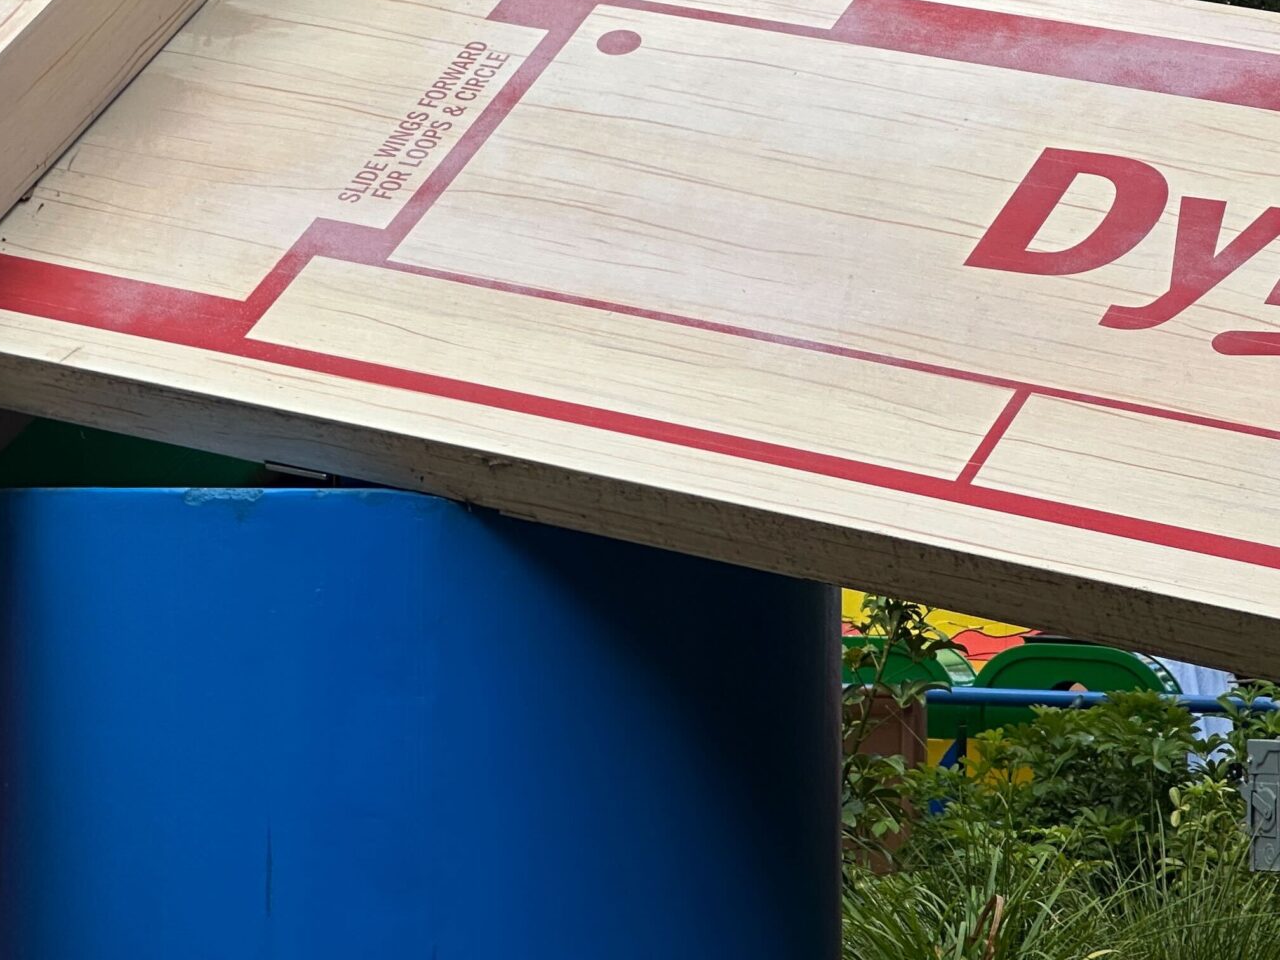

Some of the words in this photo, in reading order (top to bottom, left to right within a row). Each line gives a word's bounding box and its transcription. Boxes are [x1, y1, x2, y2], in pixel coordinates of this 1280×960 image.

[454, 51, 510, 101] CIRCLE
[338, 161, 388, 203] SLIDE
[374, 111, 430, 157] WINGS
[417, 41, 488, 109] FORWARD
[442, 106, 467, 117] &
[399, 120, 452, 168] LOOPS
[371, 170, 412, 200] FOR
[963, 147, 1280, 330] Dy
